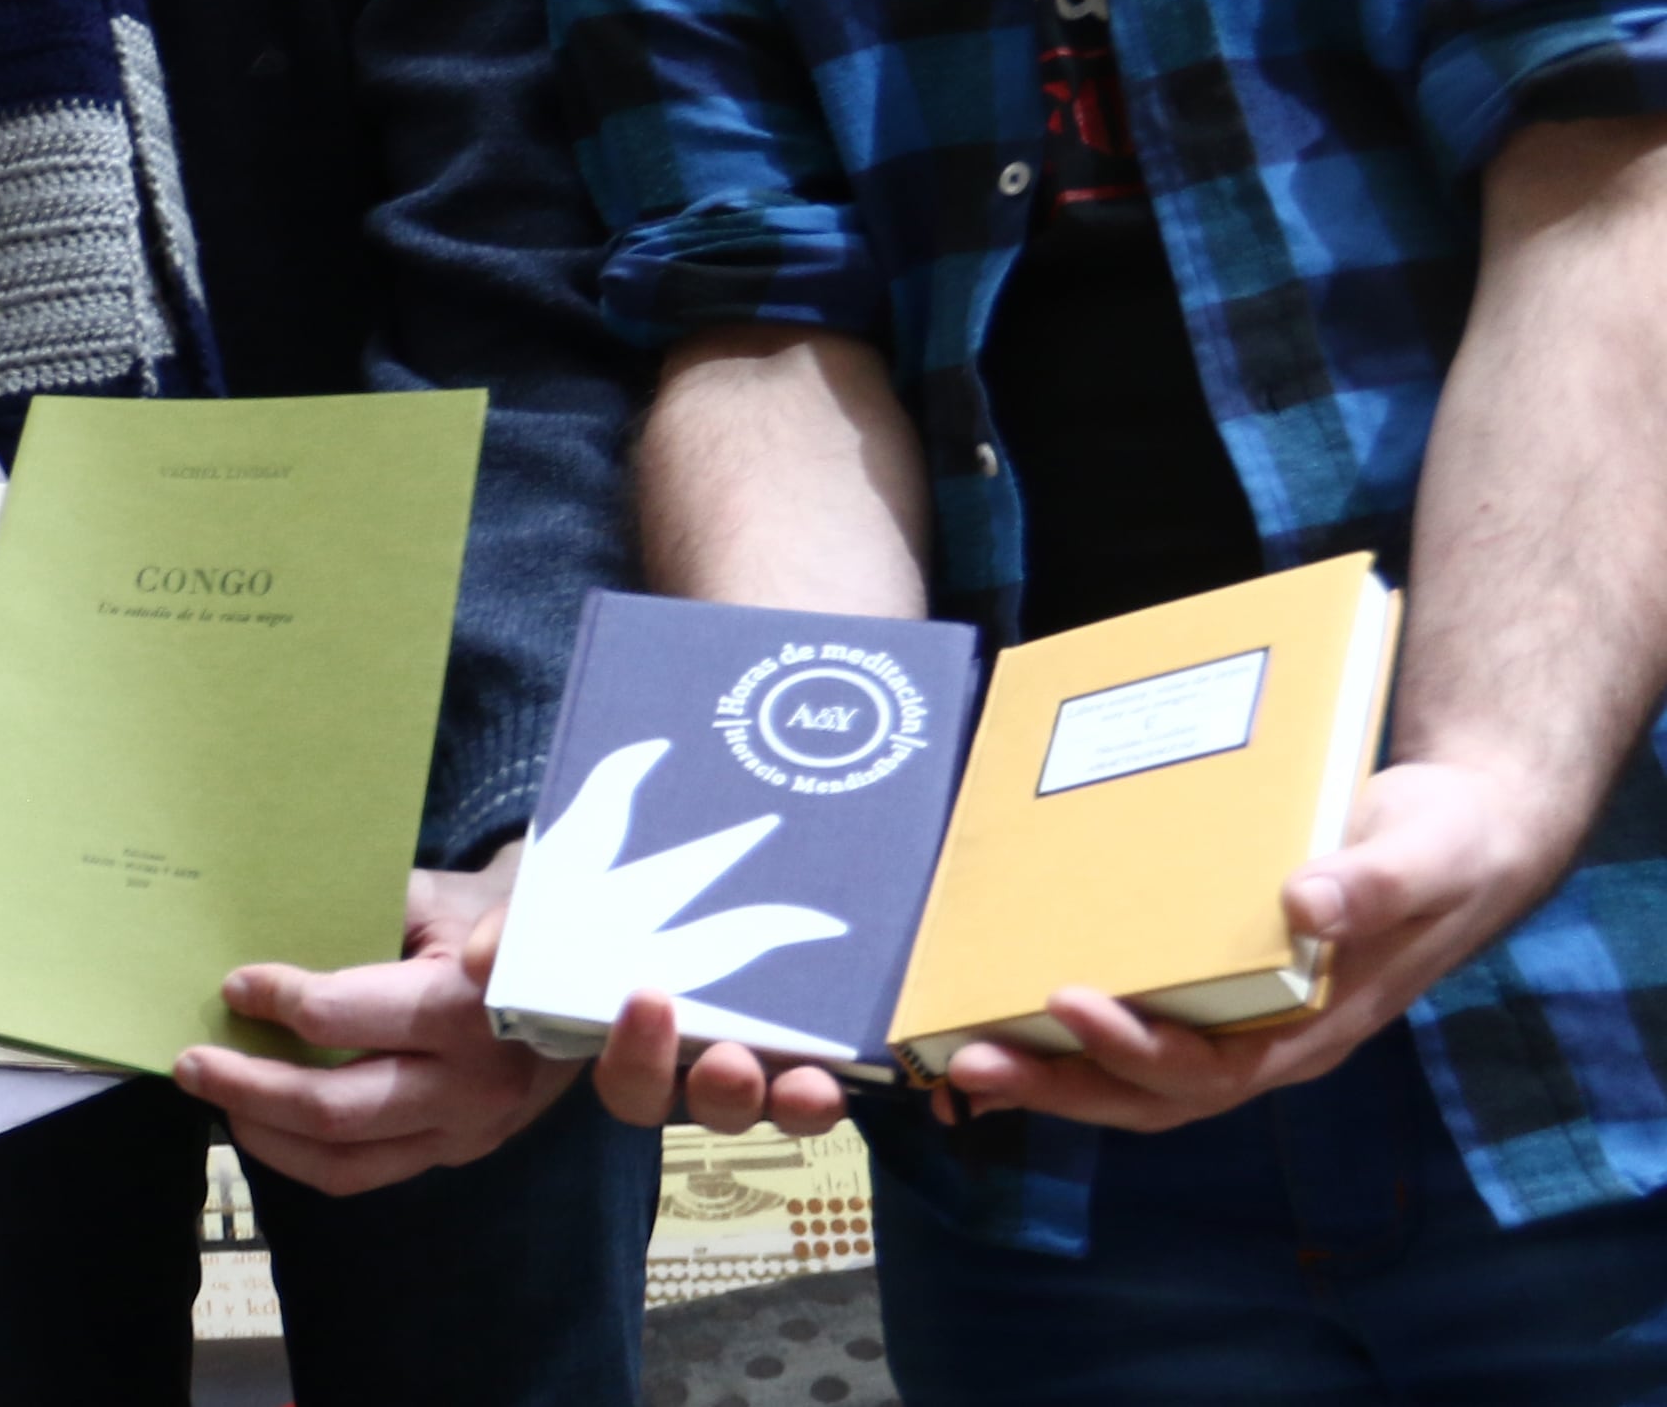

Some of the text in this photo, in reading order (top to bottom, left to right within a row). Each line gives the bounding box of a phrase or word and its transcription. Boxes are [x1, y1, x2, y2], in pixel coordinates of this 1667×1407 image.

[134, 565, 274, 596] CONGO
[176, 608, 194, 621] de
[715, 642, 930, 735] Horas de meditación
